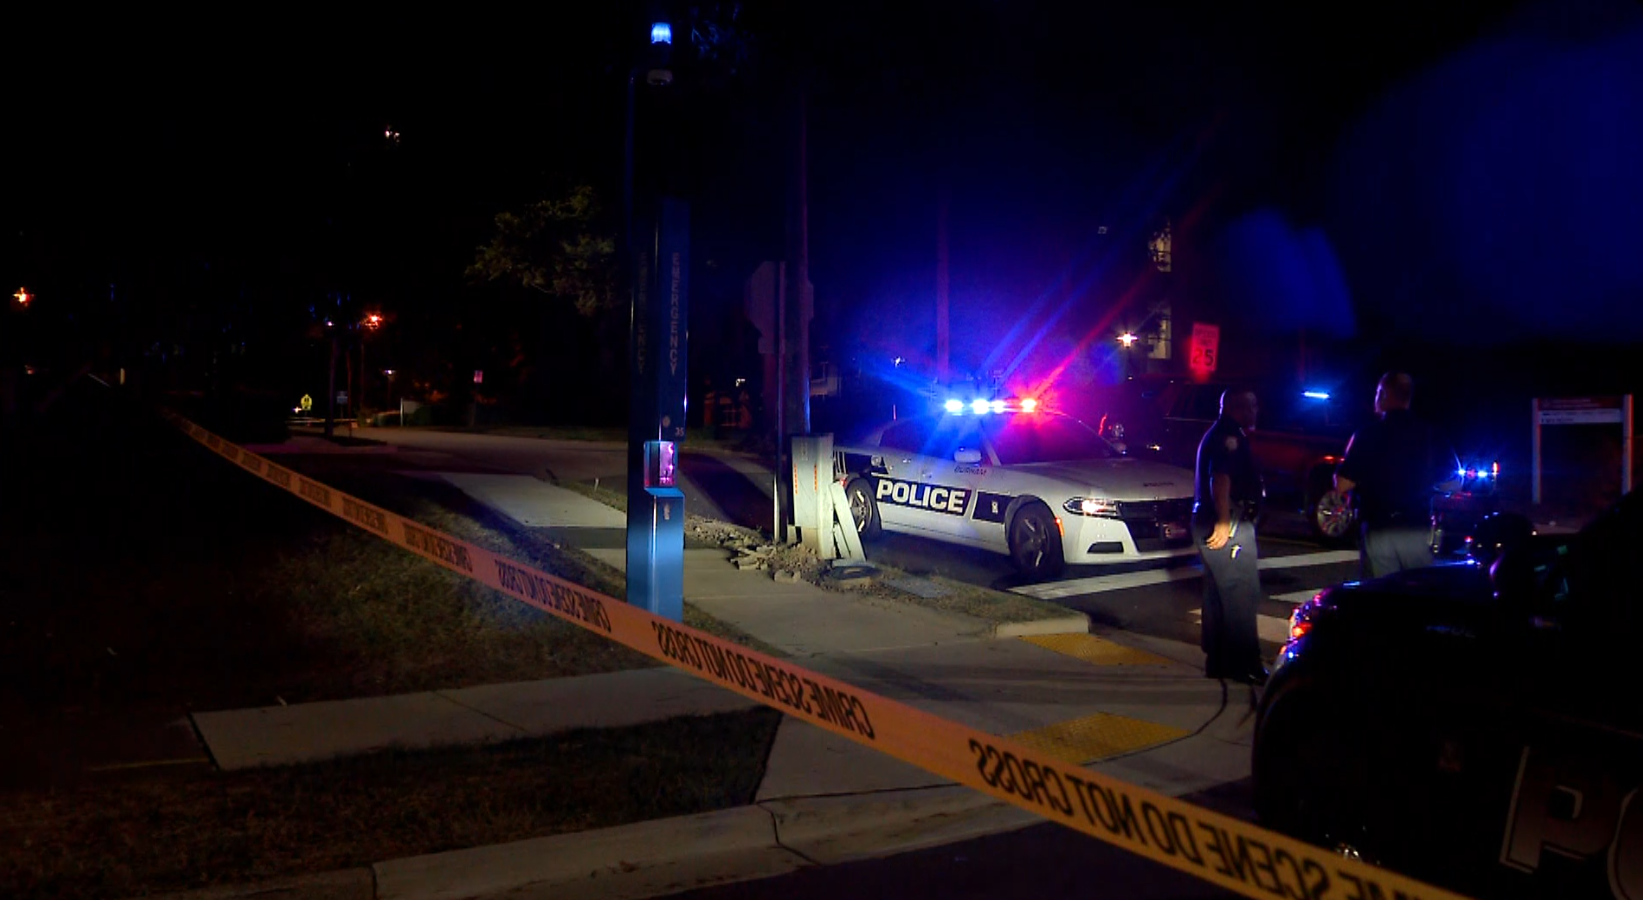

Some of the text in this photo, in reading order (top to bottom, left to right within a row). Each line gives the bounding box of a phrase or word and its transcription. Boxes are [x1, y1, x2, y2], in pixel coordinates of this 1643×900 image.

[669, 252, 680, 376] EMERGENCY
[1193, 347, 1215, 367] 25
[876, 479, 966, 513] POLICE
